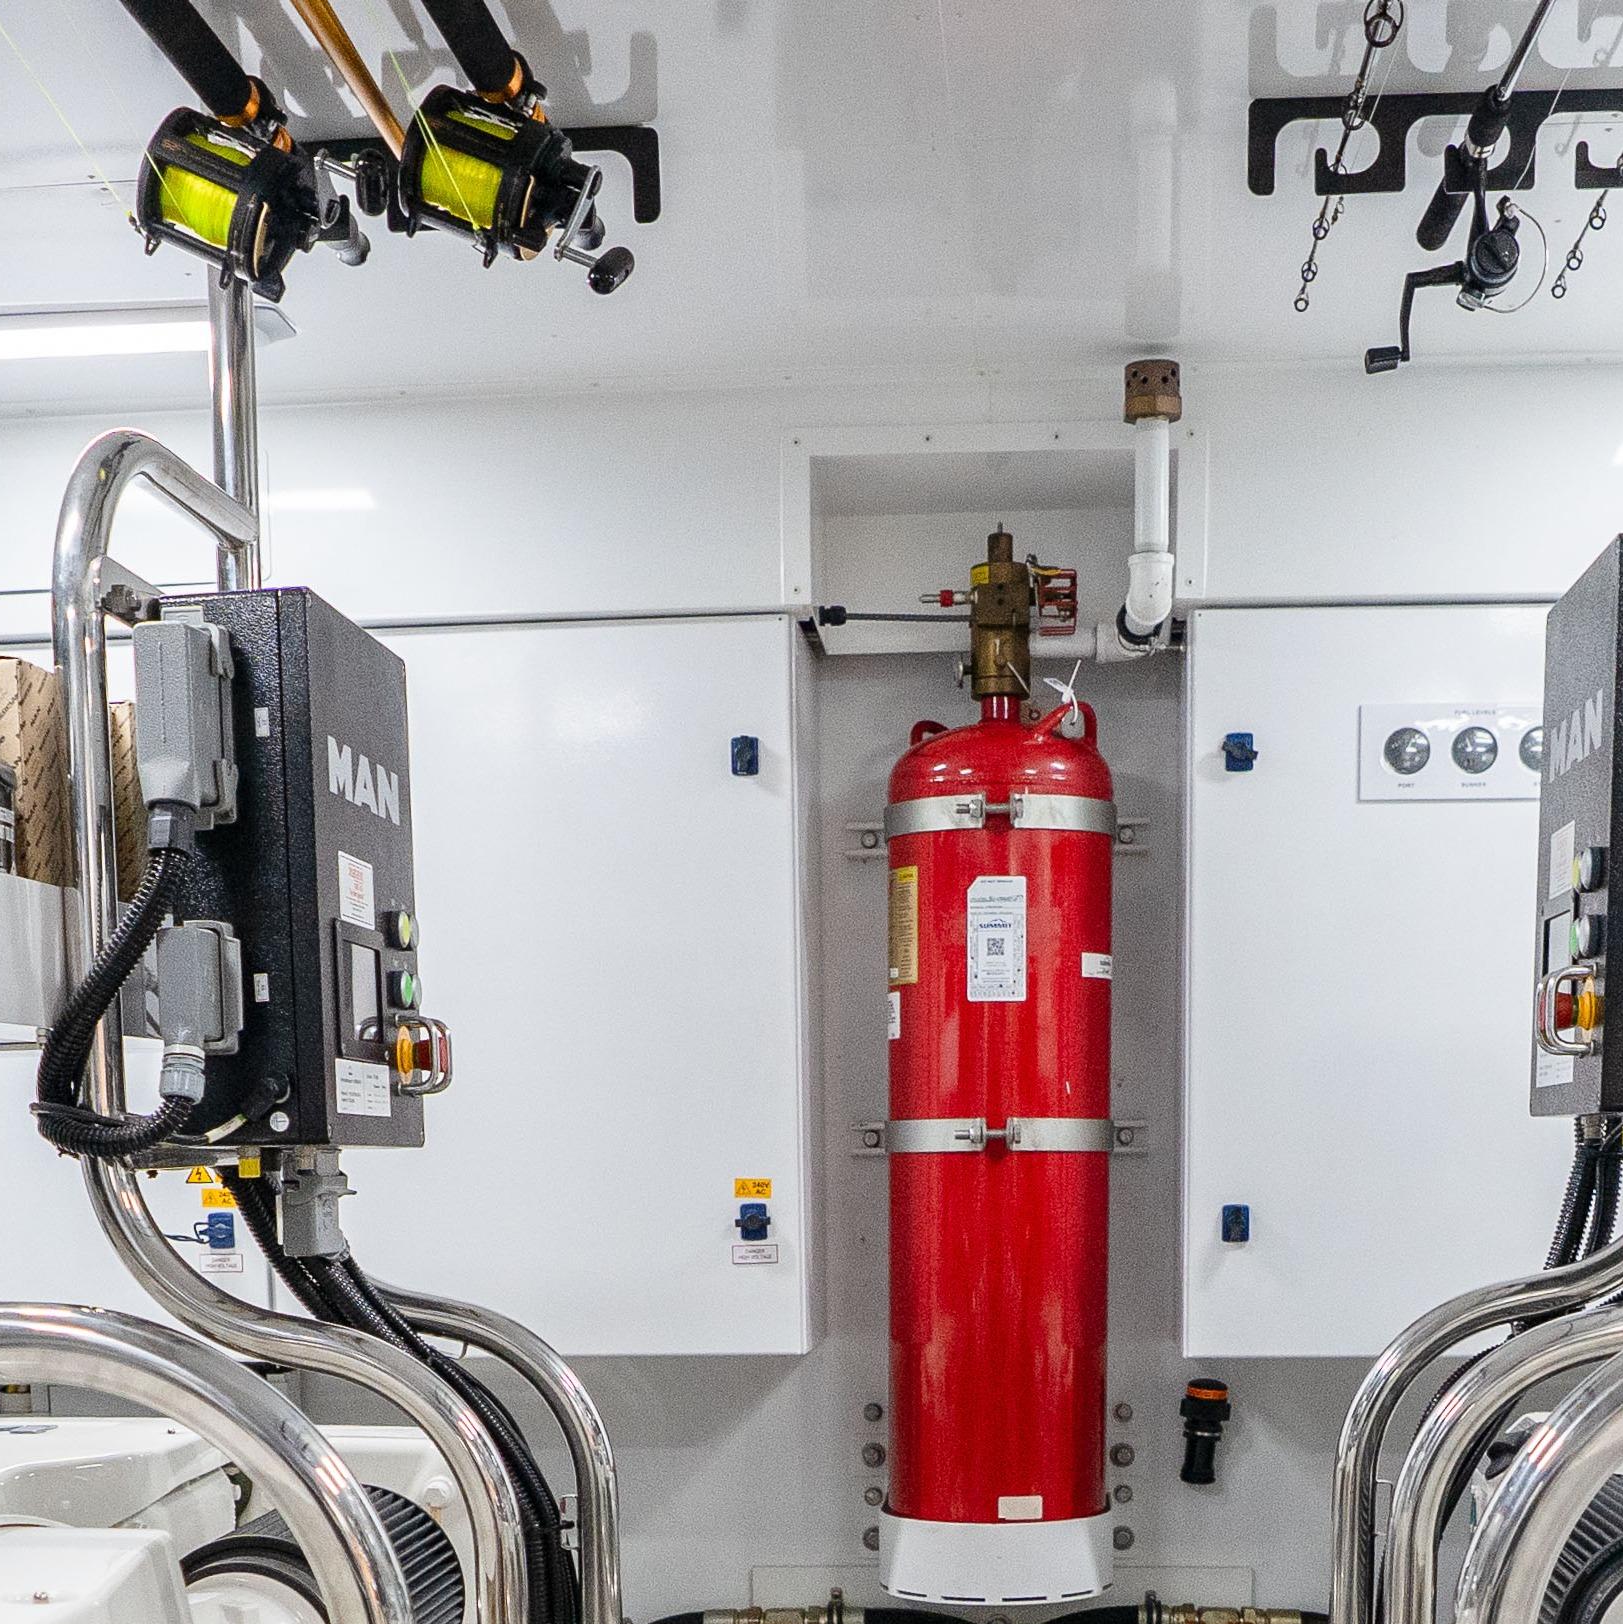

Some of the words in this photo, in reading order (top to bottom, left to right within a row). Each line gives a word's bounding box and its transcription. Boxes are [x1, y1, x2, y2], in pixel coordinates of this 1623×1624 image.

[1549, 688, 1603, 782] MAN
[326, 734, 402, 826] MAN
[978, 922, 1012, 930] SUMMIT
[752, 1181, 770, 1189] 240V
